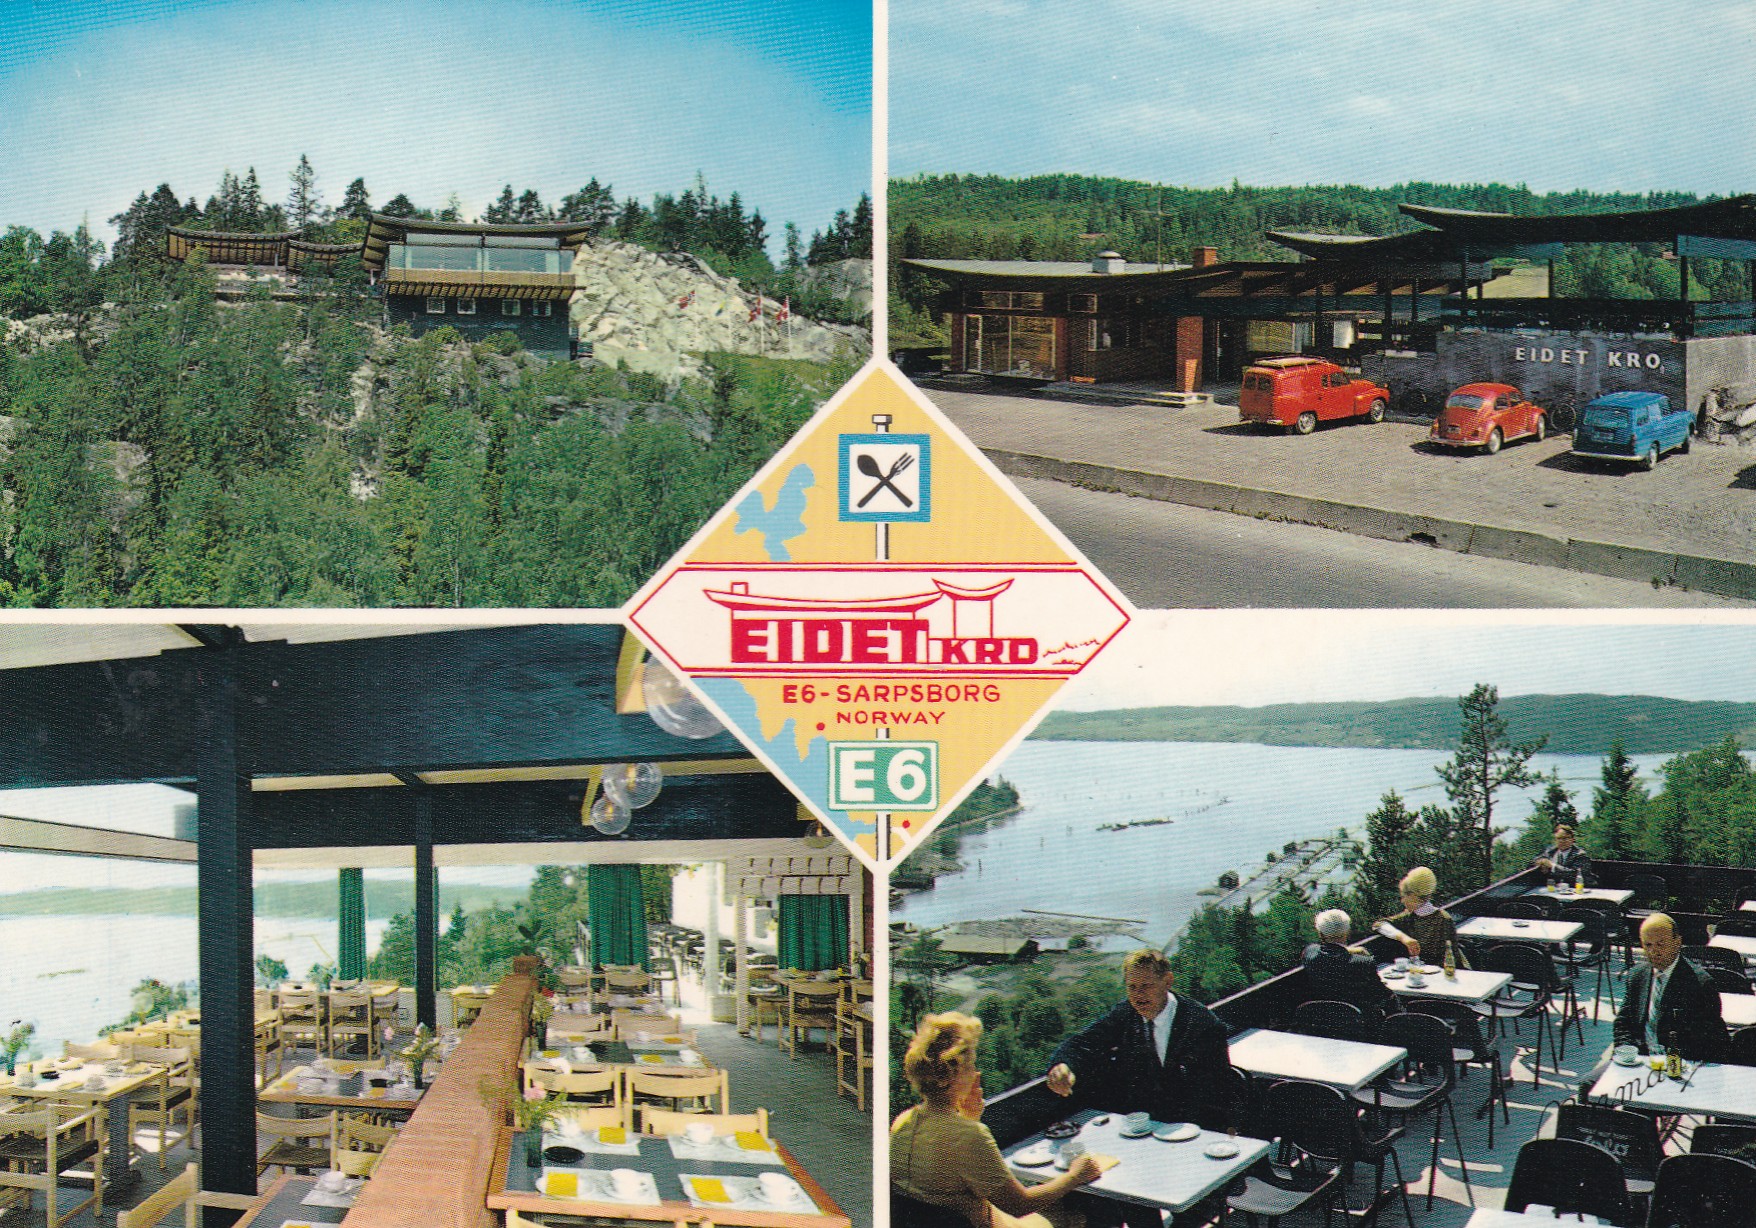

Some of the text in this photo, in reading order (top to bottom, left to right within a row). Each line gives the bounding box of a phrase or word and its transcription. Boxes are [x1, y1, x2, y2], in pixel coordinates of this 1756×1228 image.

[1515, 347, 1661, 370] EIDET KRO
[731, 619, 929, 663] EIDET
[836, 711, 946, 725] NORWAY
